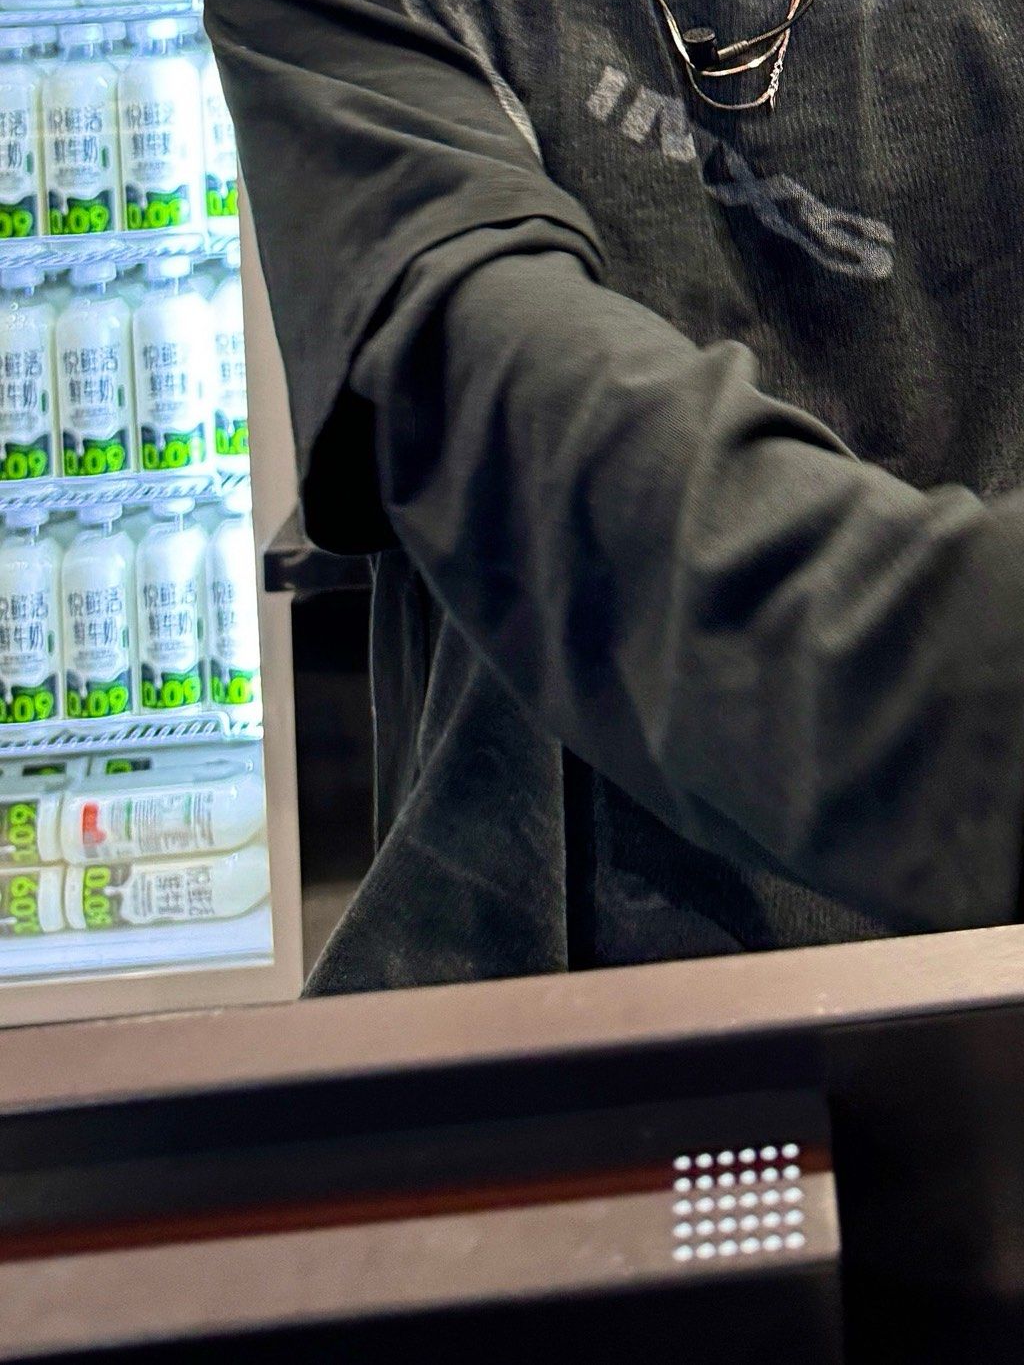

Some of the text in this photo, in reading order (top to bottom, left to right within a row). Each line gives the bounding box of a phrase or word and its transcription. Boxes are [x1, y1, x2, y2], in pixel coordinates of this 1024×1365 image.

[50, 204, 110, 235] 0.09
[64, 444, 126, 477] 0.09
[67, 685, 130, 719] 0.09
[143, 677, 201, 709] 0.09
